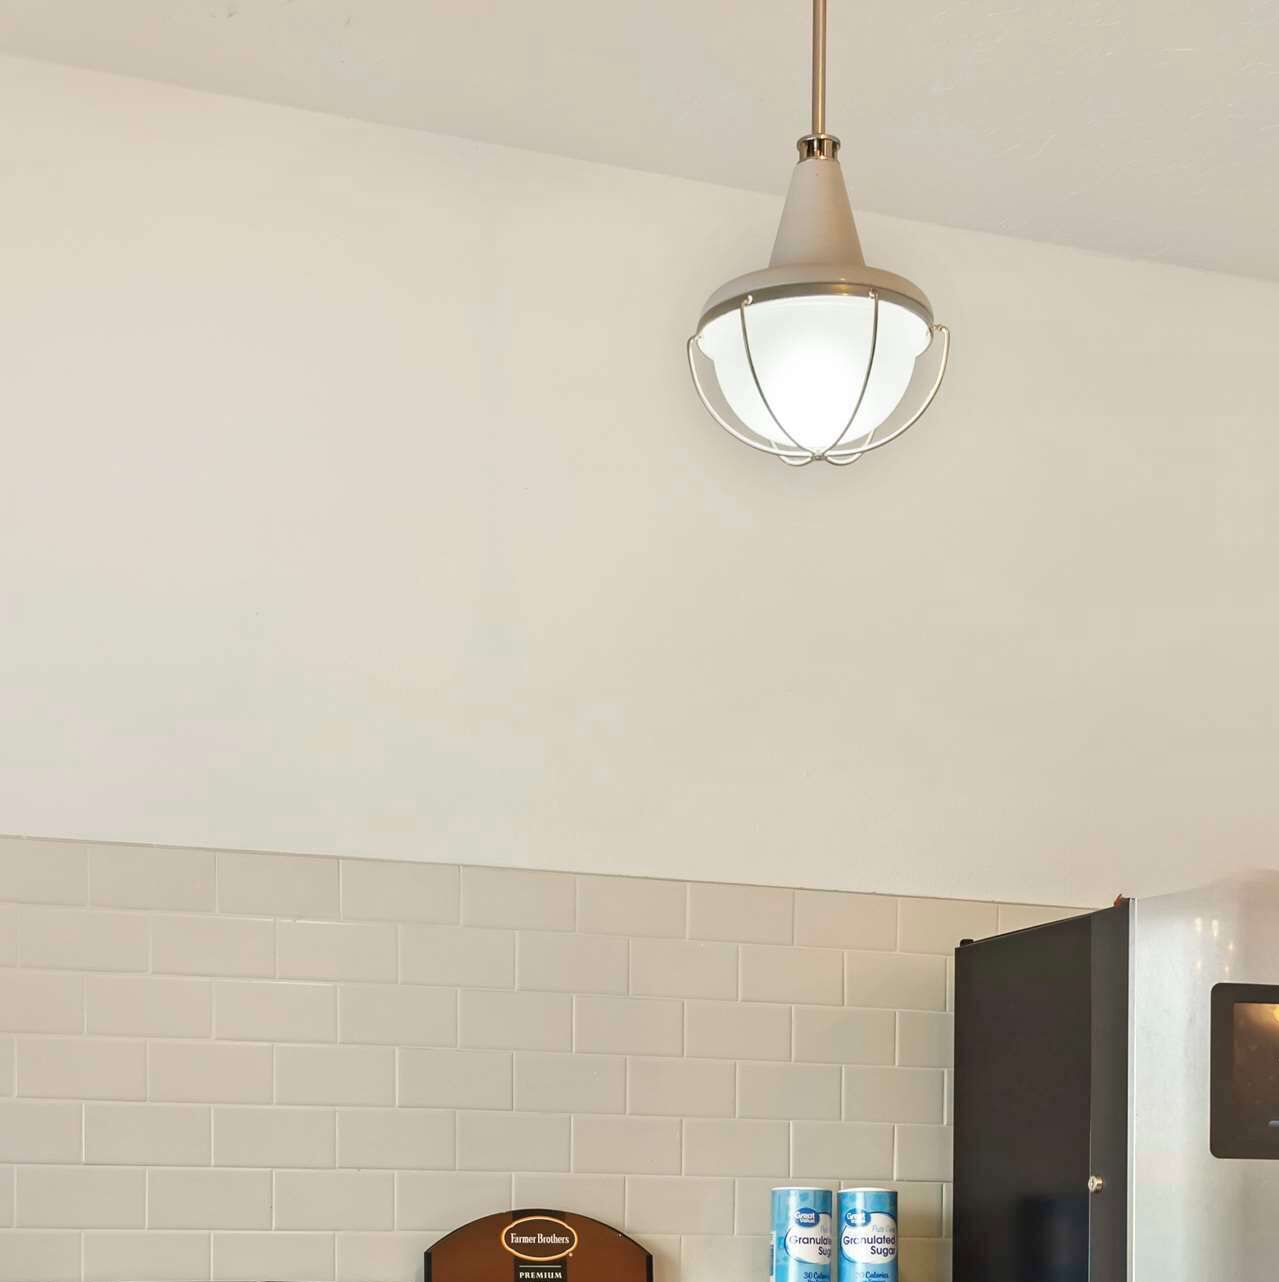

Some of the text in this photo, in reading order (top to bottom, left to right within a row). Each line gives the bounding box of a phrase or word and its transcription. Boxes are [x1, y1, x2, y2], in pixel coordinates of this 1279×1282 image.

[510, 1233, 570, 1244] Farmer Brothers
[843, 1235, 896, 1245] Granulated
[519, 1271, 563, 1279] PREMIUM
